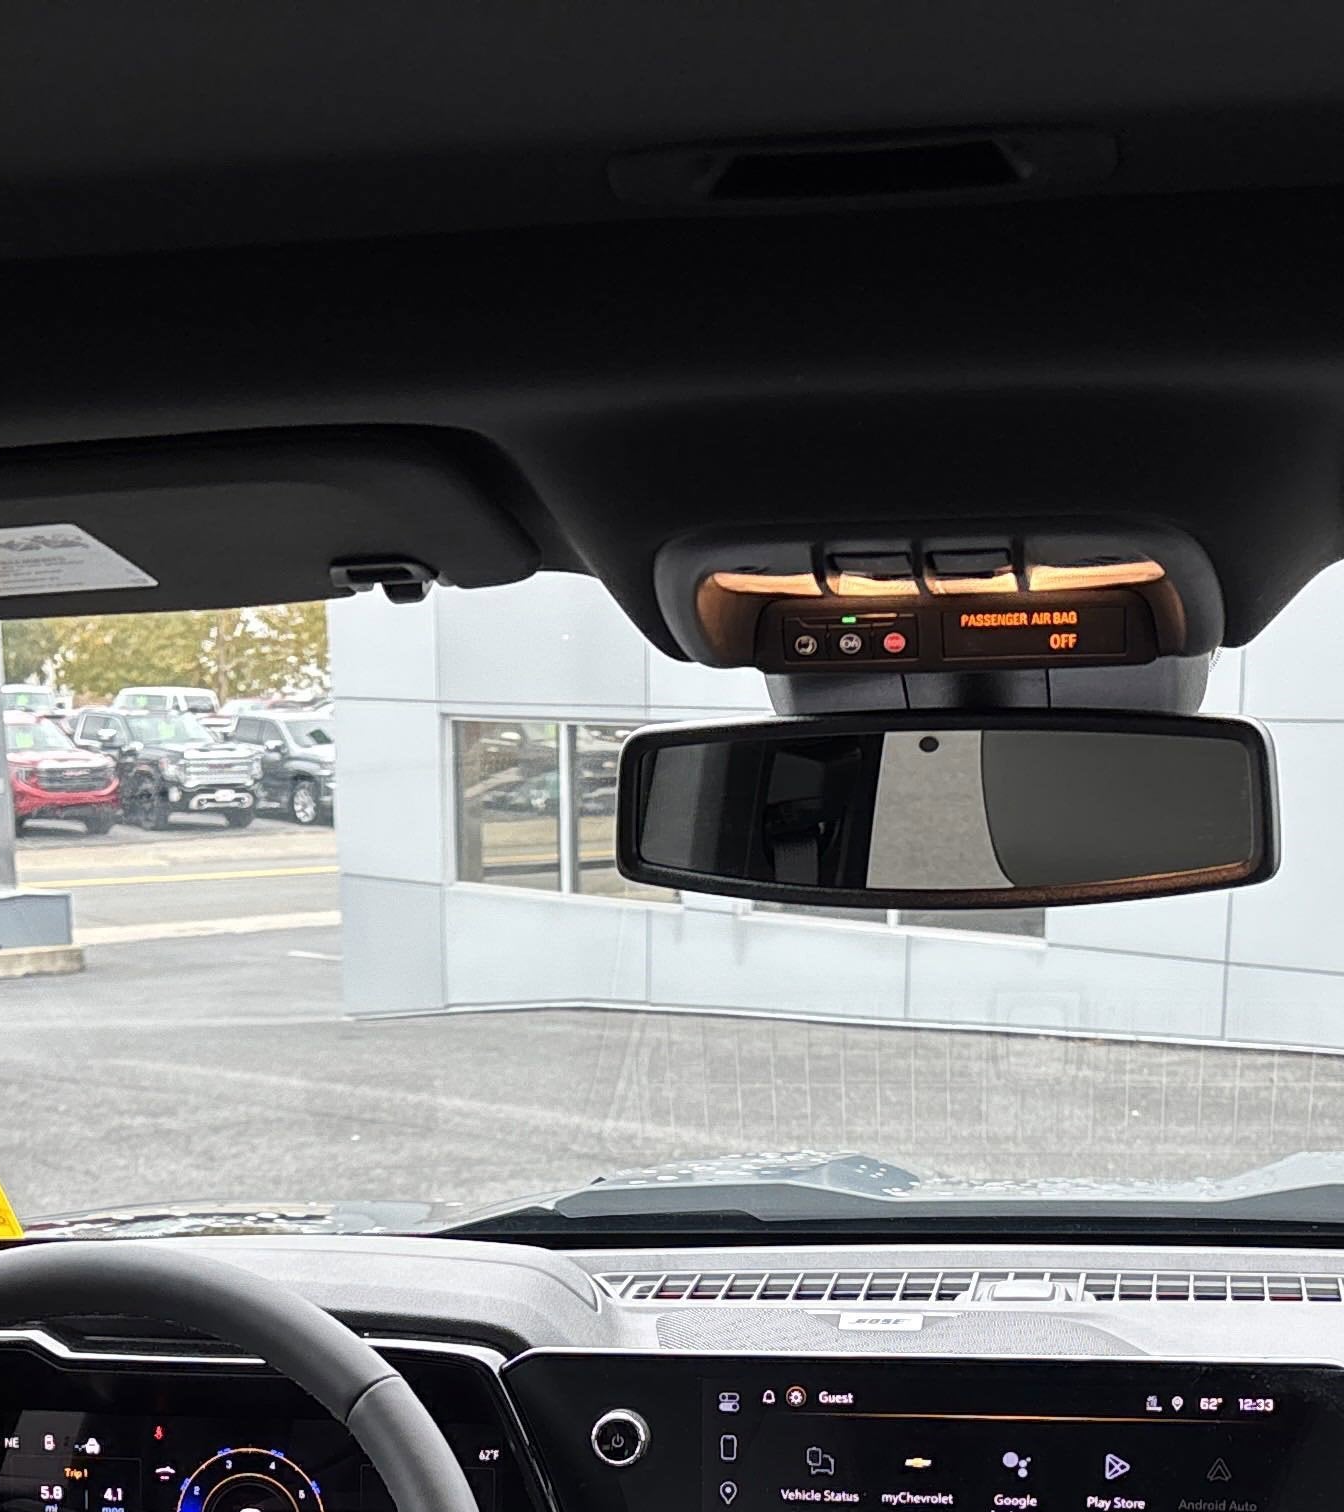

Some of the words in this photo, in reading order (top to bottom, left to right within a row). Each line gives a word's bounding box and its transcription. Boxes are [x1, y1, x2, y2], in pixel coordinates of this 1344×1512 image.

[960, 613, 1029, 627] PASSENGER
[1032, 612, 1052, 626] AIR
[1053, 611, 1077, 625] BAG
[1050, 633, 1077, 649] OFF
[818, 1390, 853, 1404] Guest
[1238, 1398, 1274, 1411] 12:33
[4, 1437, 20, 1449] NE
[225, 1459, 233, 1469] 3
[269, 1461, 276, 1470] 4
[64, 1467, 82, 1480] Trip
[103, 1487, 123, 1501] 4.1
[781, 1489, 822, 1501] Vehicle
[824, 1490, 859, 1502] Status
[881, 1492, 954, 1505] myChevrolet
[44, 1504, 58, 1512] mi
[994, 1495, 1037, 1508] Google
[1086, 1496, 1112, 1511] Play
[1114, 1497, 1146, 1510] Store
[1178, 1499, 1226, 1511] Android
[1229, 1500, 1258, 1512] Auto
